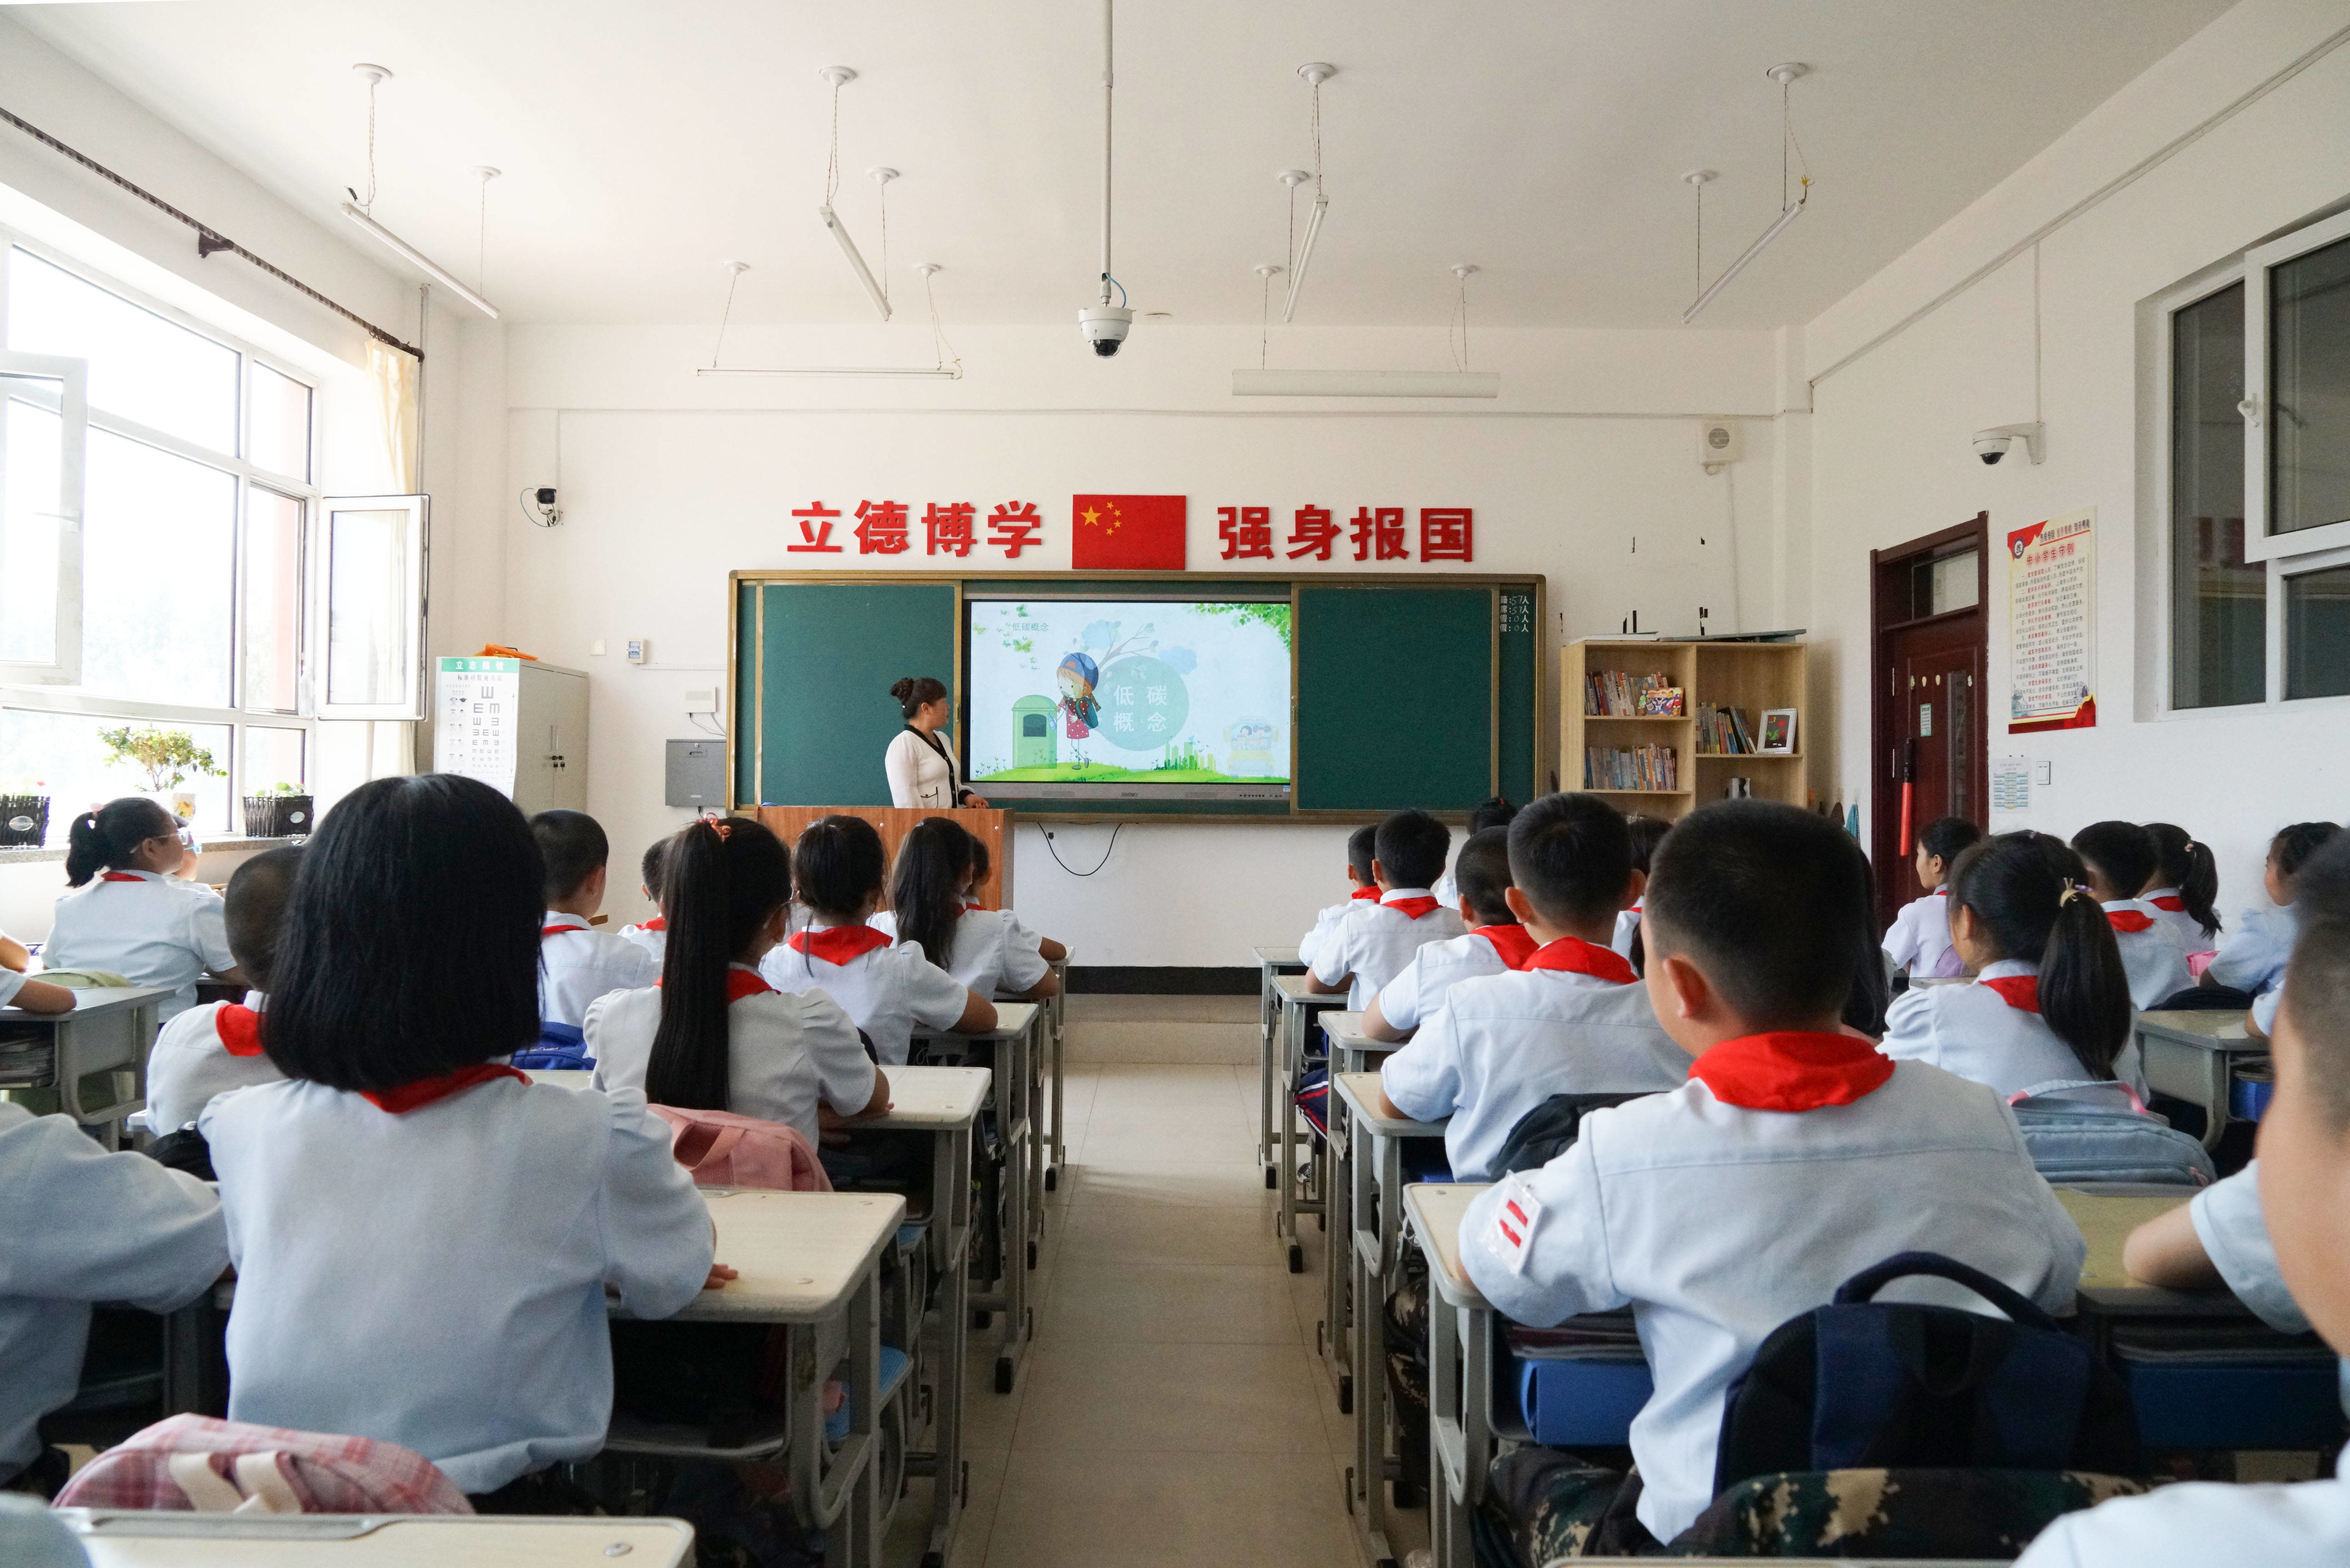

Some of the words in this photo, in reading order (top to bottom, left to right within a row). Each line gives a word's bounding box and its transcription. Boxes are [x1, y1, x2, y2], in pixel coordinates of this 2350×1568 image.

[787, 500, 1041, 558] 立德博学
[1217, 504, 1472, 563] 强身报国
[2026, 543, 2074, 566] 中小学生守则
[1012, 622, 1049, 632] 低碳概念
